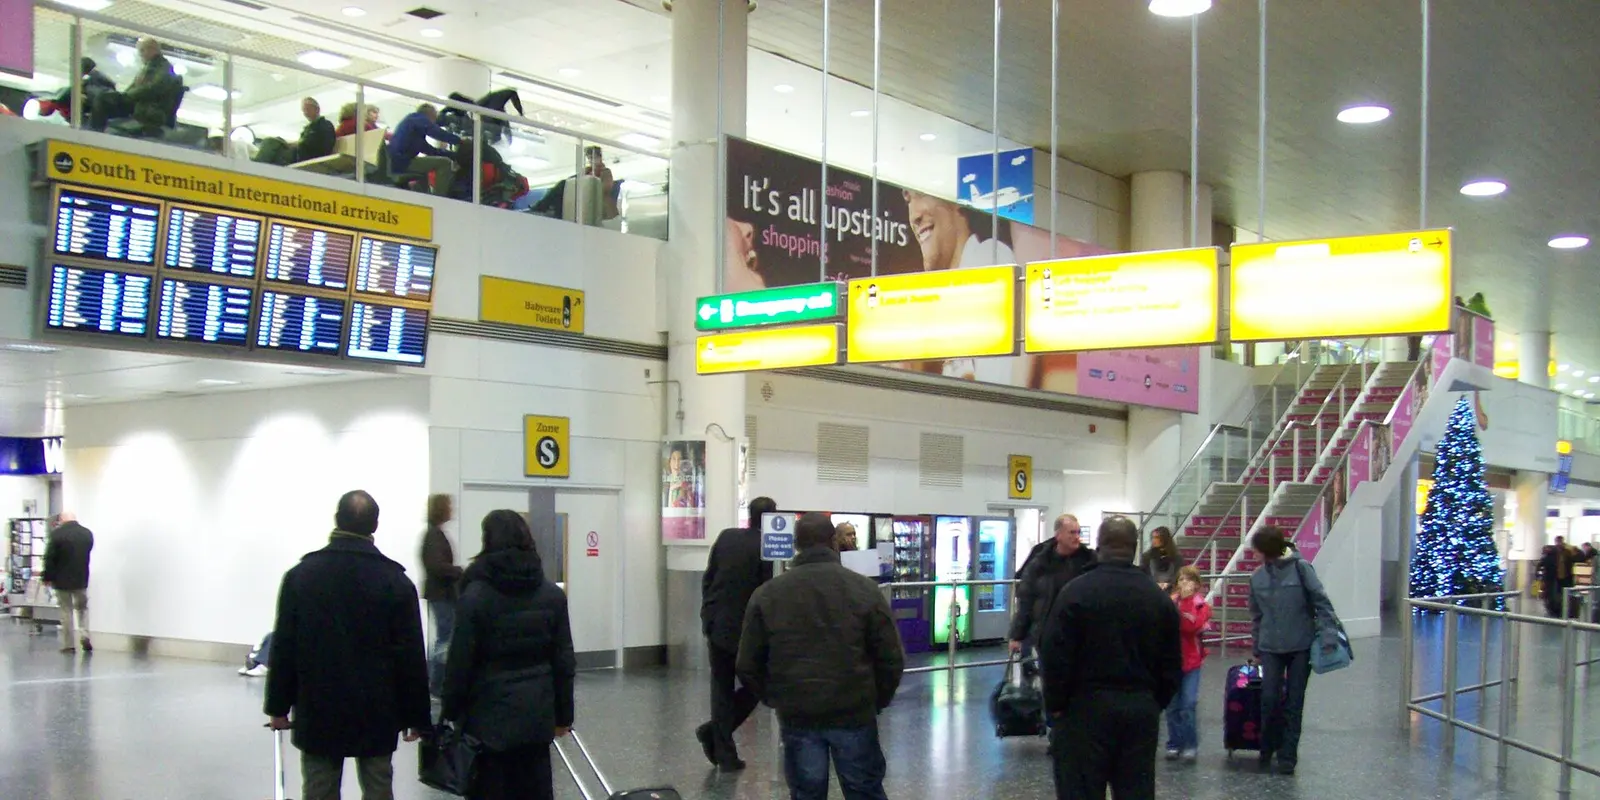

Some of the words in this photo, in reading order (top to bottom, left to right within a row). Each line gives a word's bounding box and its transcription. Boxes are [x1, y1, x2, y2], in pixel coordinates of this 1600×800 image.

[79, 157, 136, 180] South
[141, 168, 224, 195] Terminal
[228, 182, 337, 215] International
[341, 204, 399, 226] arrivals
[825, 185, 853, 200] ashion
[744, 175, 780, 215] It's
[787, 188, 816, 225] all
[824, 204, 907, 246] upstairs
[524, 301, 562, 314] Babycare
[536, 313, 561, 325] Toilets
[535, 422, 560, 433] Zone
[540, 439, 554, 465] S
[1017, 472, 1025, 491] S
